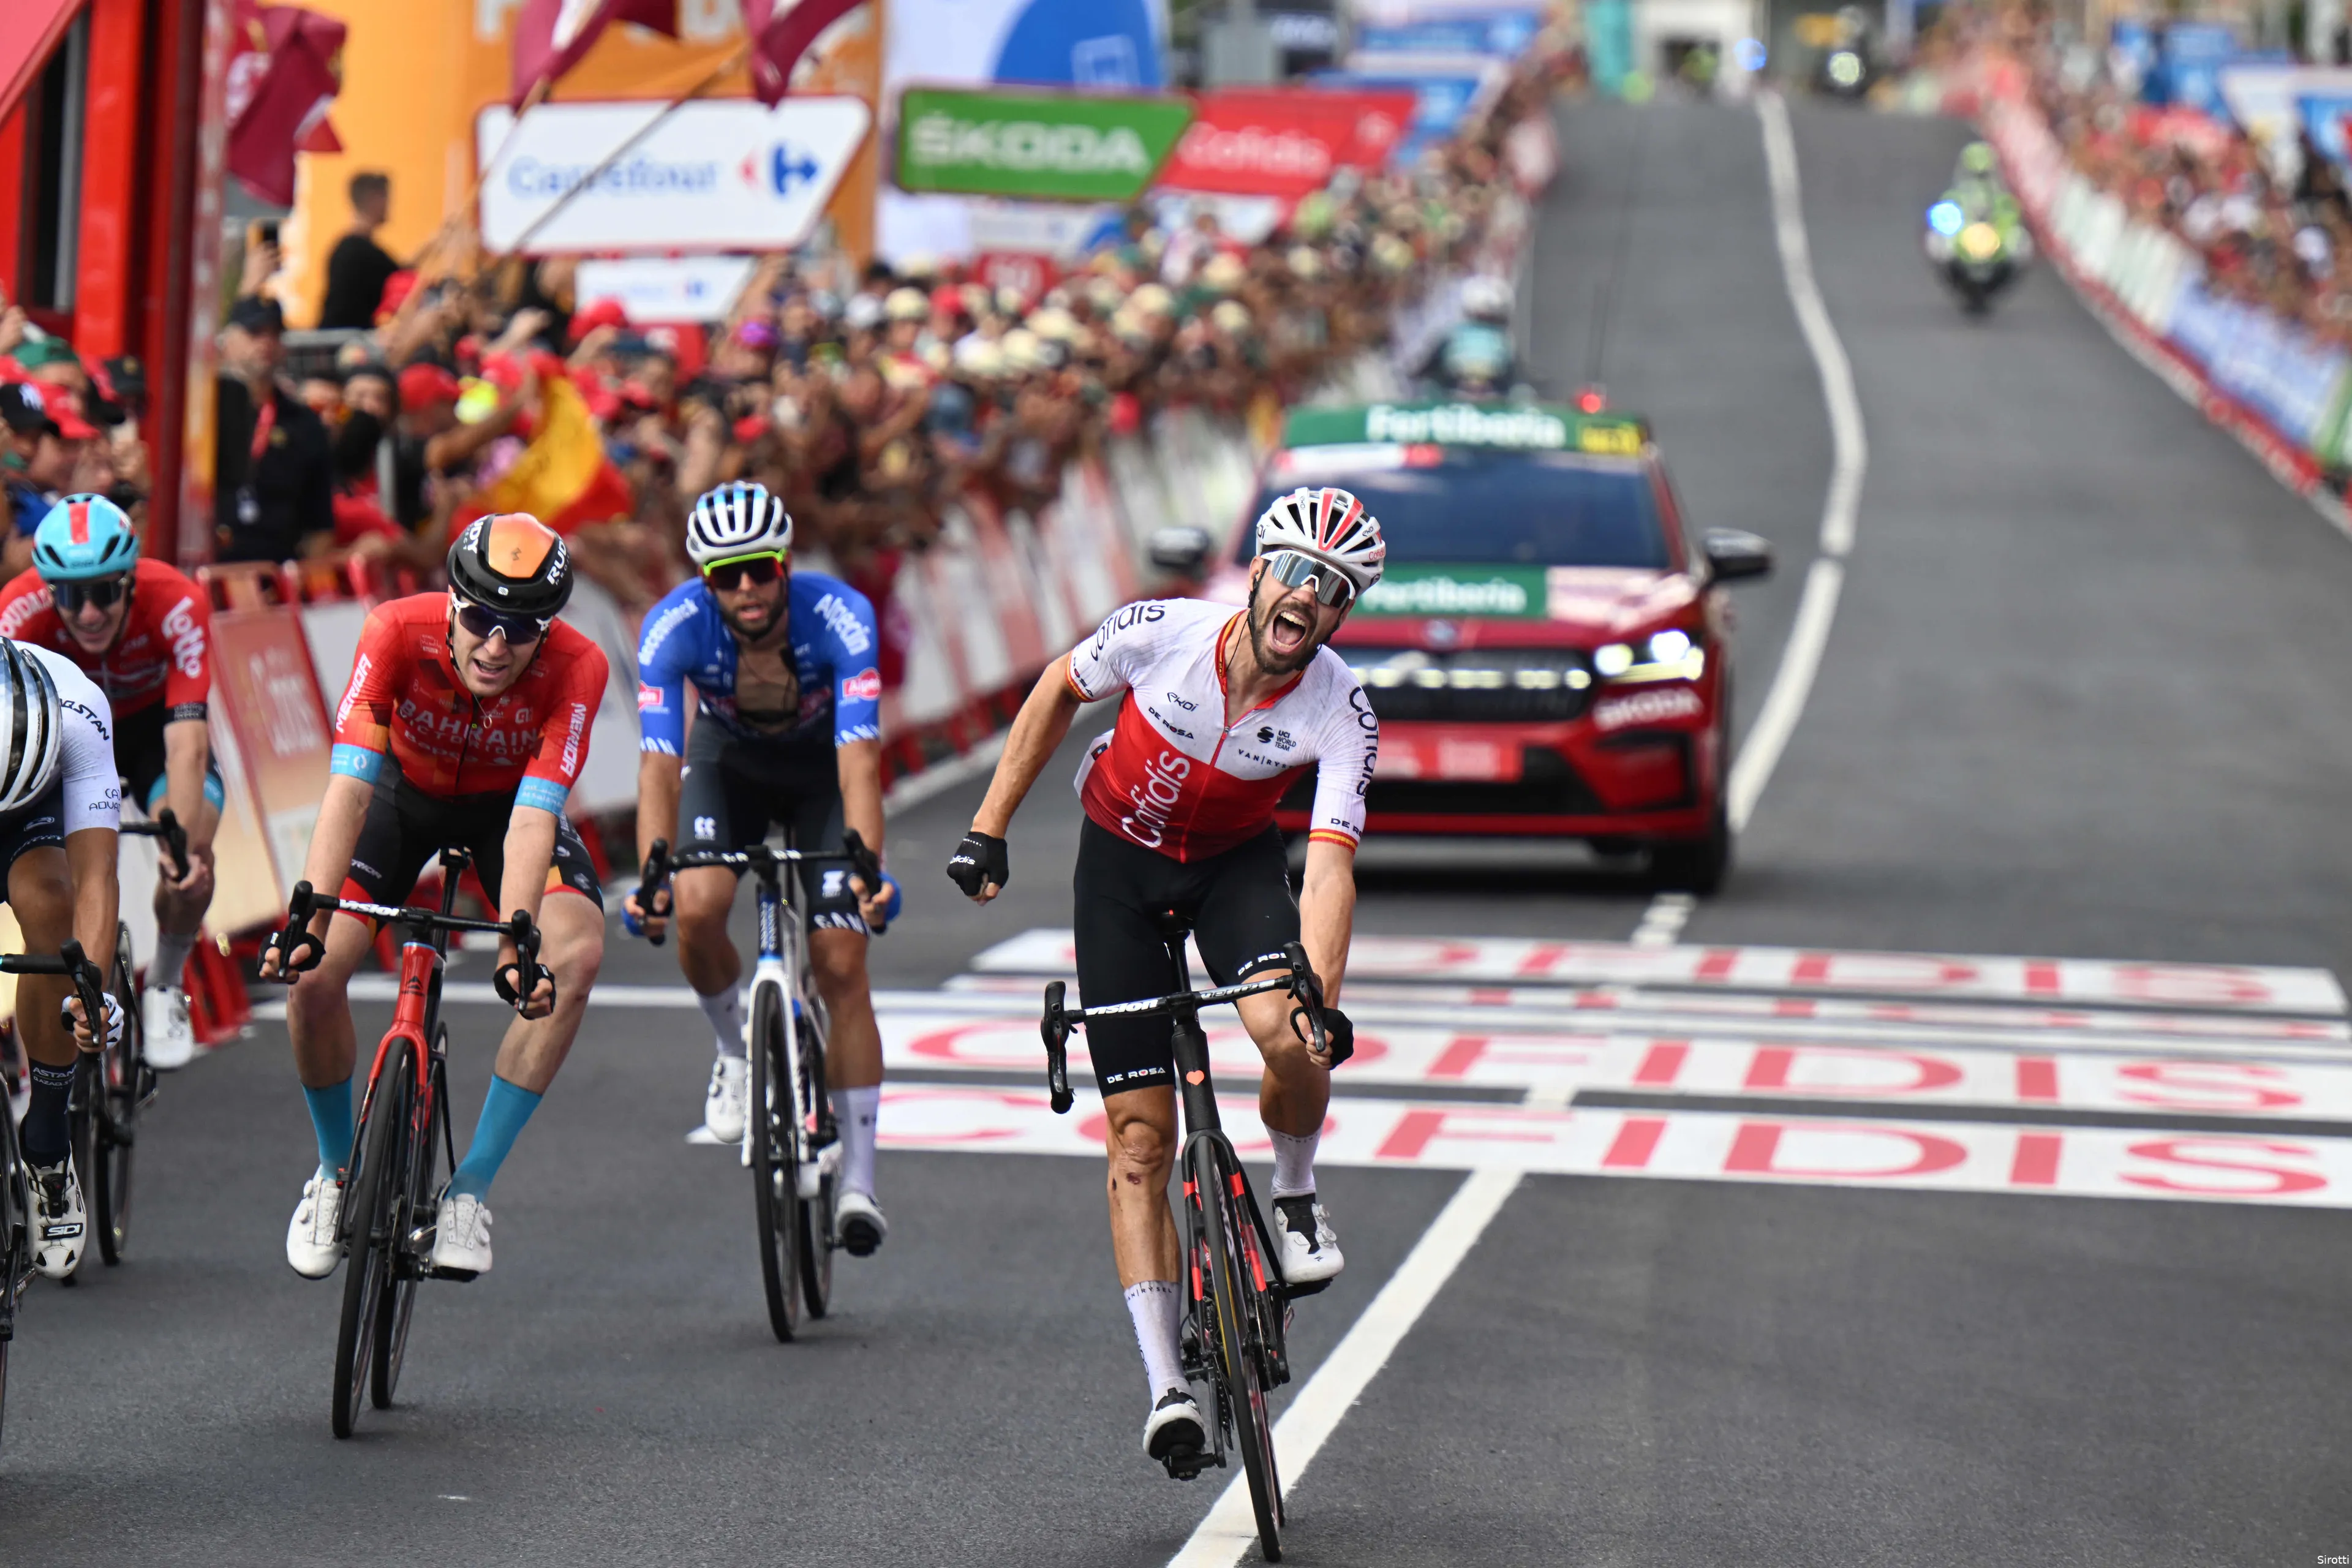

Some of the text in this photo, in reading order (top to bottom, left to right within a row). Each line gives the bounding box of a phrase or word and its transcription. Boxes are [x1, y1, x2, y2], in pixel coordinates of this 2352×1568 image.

[0, 588, 53, 638] OUDAL
[813, 593, 870, 656] Alpecin
[336, 653, 372, 733] MERIDA
[399, 698, 538, 752] BAHRAIN
[1148, 706, 1194, 739] DE ROSA
[1278, 730, 1290, 739] UCI
[560, 703, 587, 778] MERIDA
[1275, 742, 1291, 752] TEAM
[1276, 736, 1297, 748] WORLD
[1121, 751, 1190, 848] Cofidis
[1330, 818, 1350, 829] DE
[33, 1064, 77, 1078] ASTAN
[1107, 1067, 1166, 1084] DE ROSA
